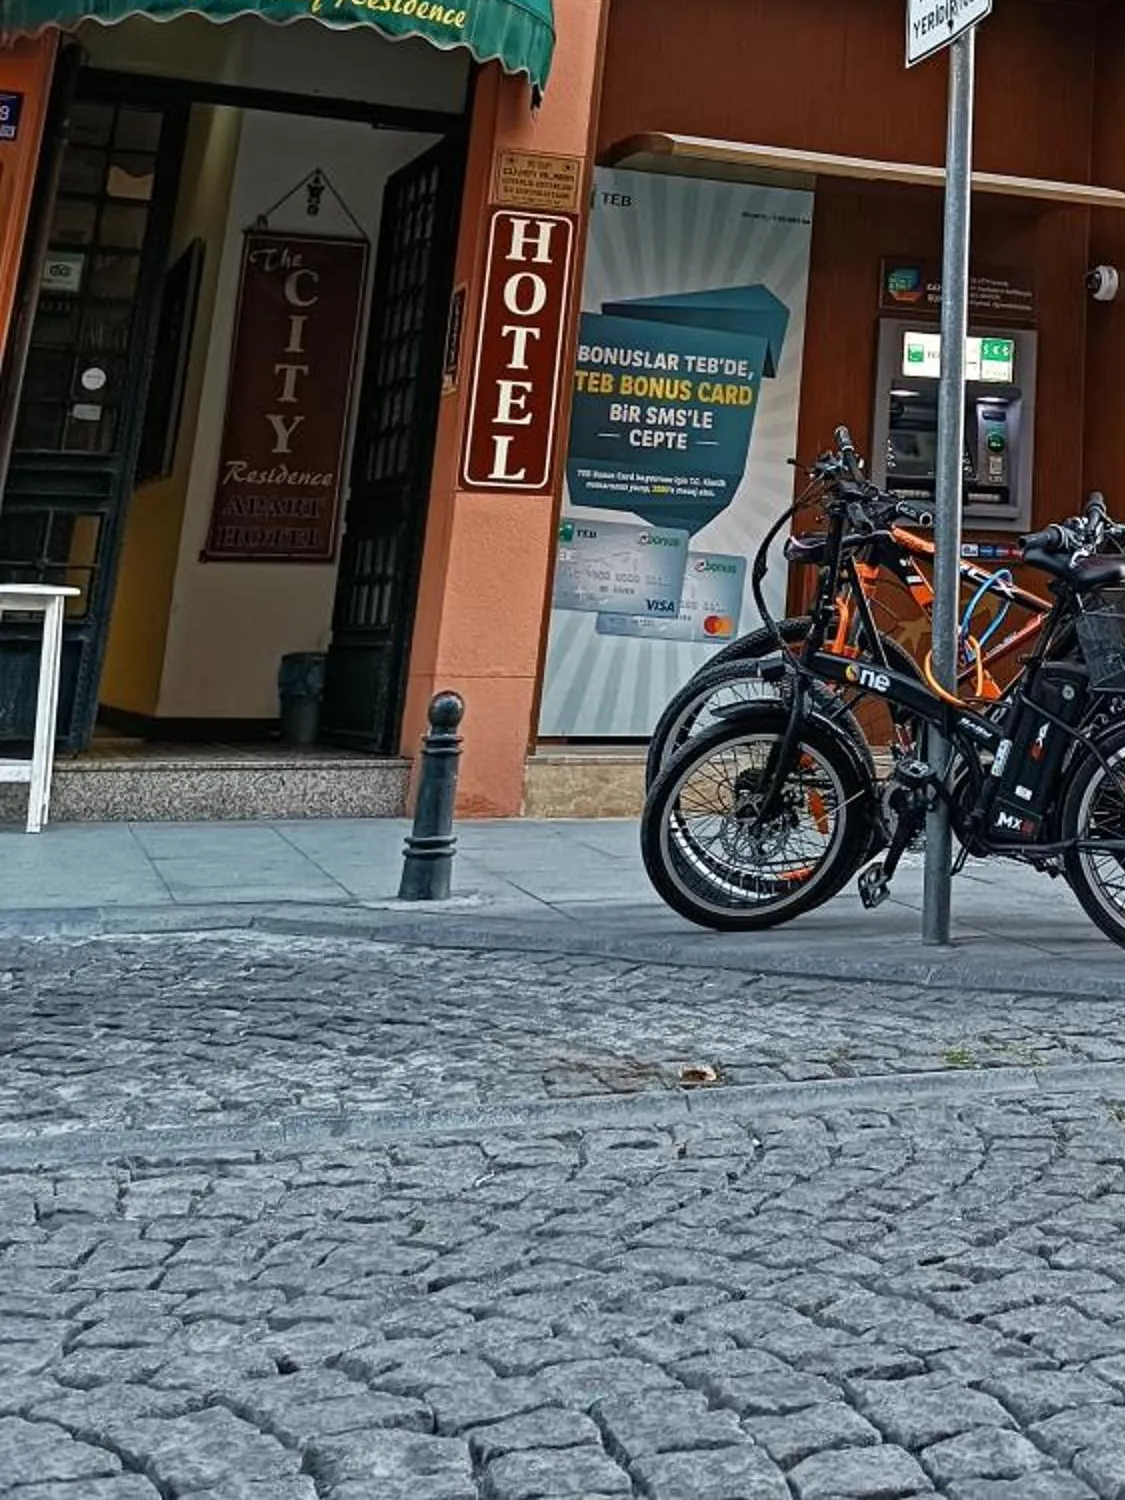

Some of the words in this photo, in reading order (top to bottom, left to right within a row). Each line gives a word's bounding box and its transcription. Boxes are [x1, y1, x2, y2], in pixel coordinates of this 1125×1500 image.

[601, 191, 632, 207] TEB
[249, 248, 303, 273] The
[265, 269, 321, 454] CITY
[487, 217, 557, 482] HOTEL
[577, 345, 680, 372] BONUSLAR
[684, 355, 755, 381] TEB'DE,
[575, 370, 614, 393] TEB
[620, 375, 693, 401] BONUS
[698, 382, 753, 406] CARD
[646, 406, 714, 430] SMS'LE
[629, 429, 688, 450] CEPTE
[222, 460, 334, 487] Residence
[645, 599, 677, 613] VISA
